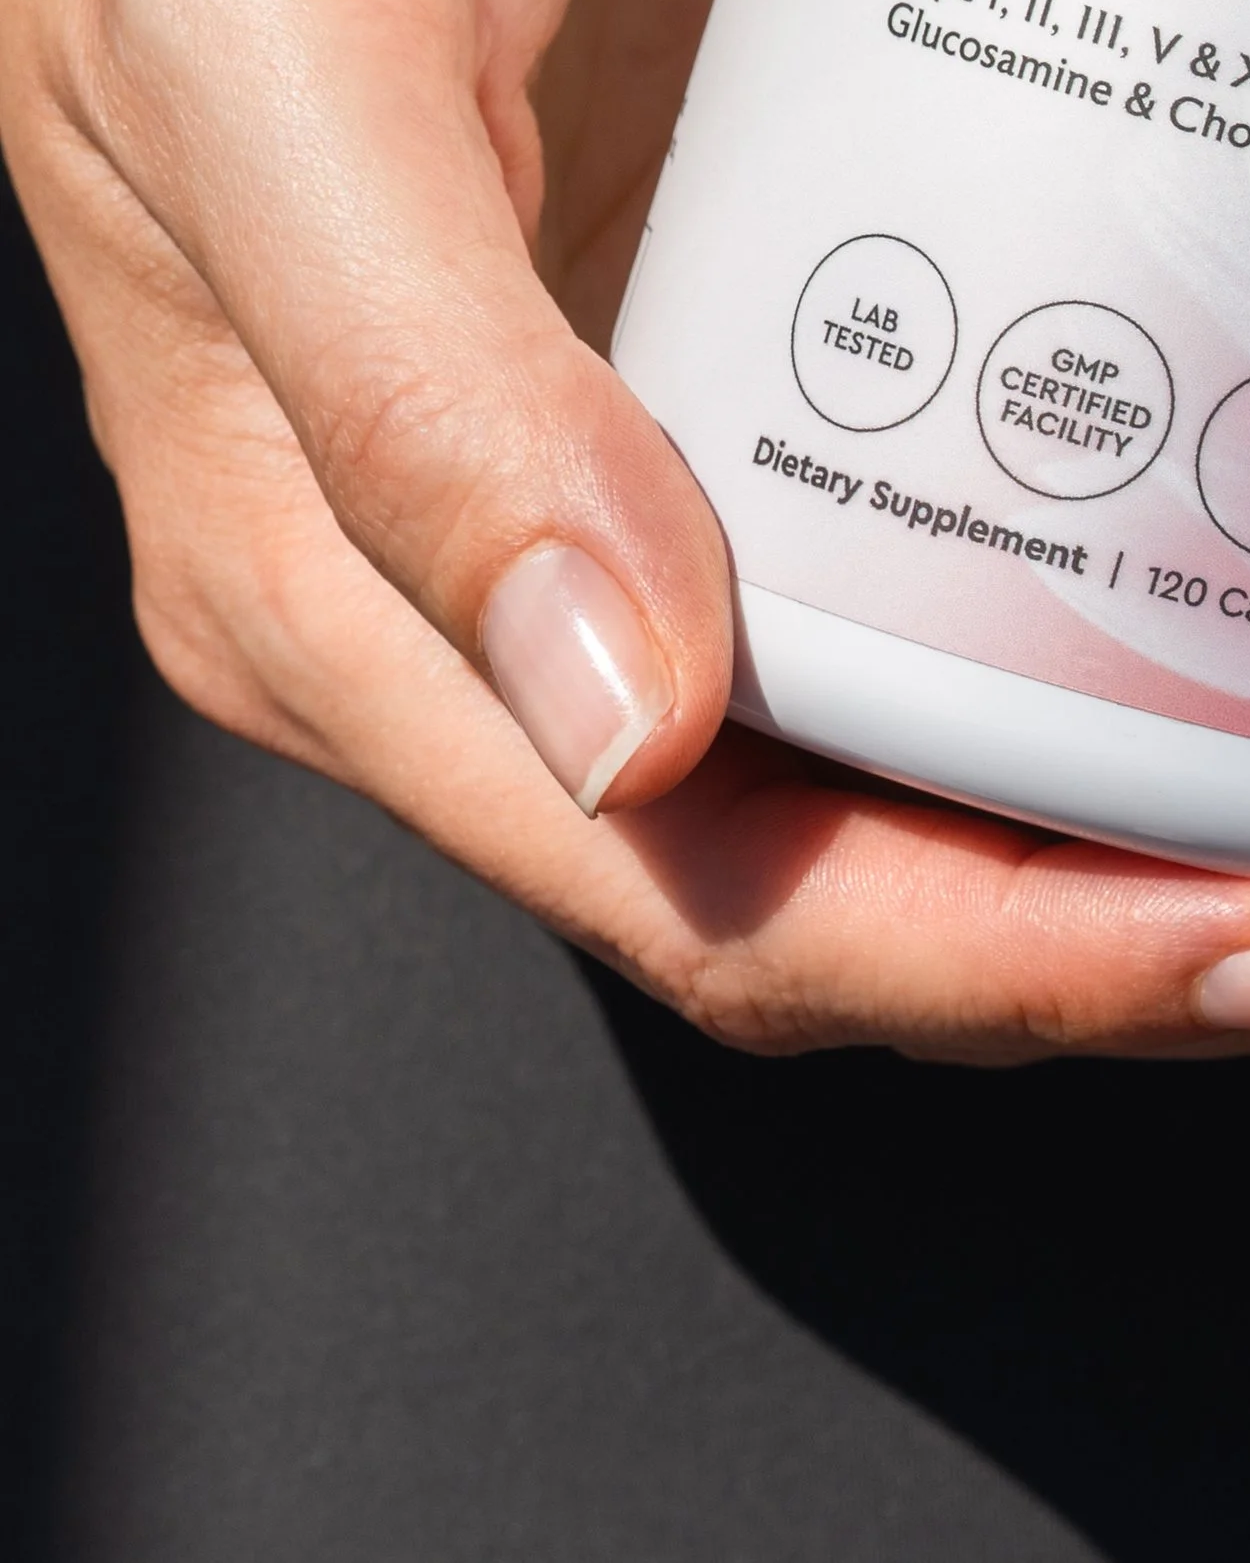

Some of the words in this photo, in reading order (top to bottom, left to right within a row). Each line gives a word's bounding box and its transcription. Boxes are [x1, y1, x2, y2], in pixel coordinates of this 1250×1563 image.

[888, 2, 1112, 105] Glucosamine
[1125, 82, 1155, 120] &
[1077, 6, 1128, 58] III,
[1153, 27, 1182, 64] V
[1190, 43, 1220, 81] &
[824, 320, 914, 371] TESTED
[851, 298, 898, 333] LAB
[1052, 349, 1119, 384] GMP
[1001, 367, 1151, 429] CERTIFIED
[1001, 399, 1133, 457] FACILITY
[753, 436, 863, 505] Dietary
[870, 481, 1088, 575] Supplement
[1149, 567, 1207, 607] 120
